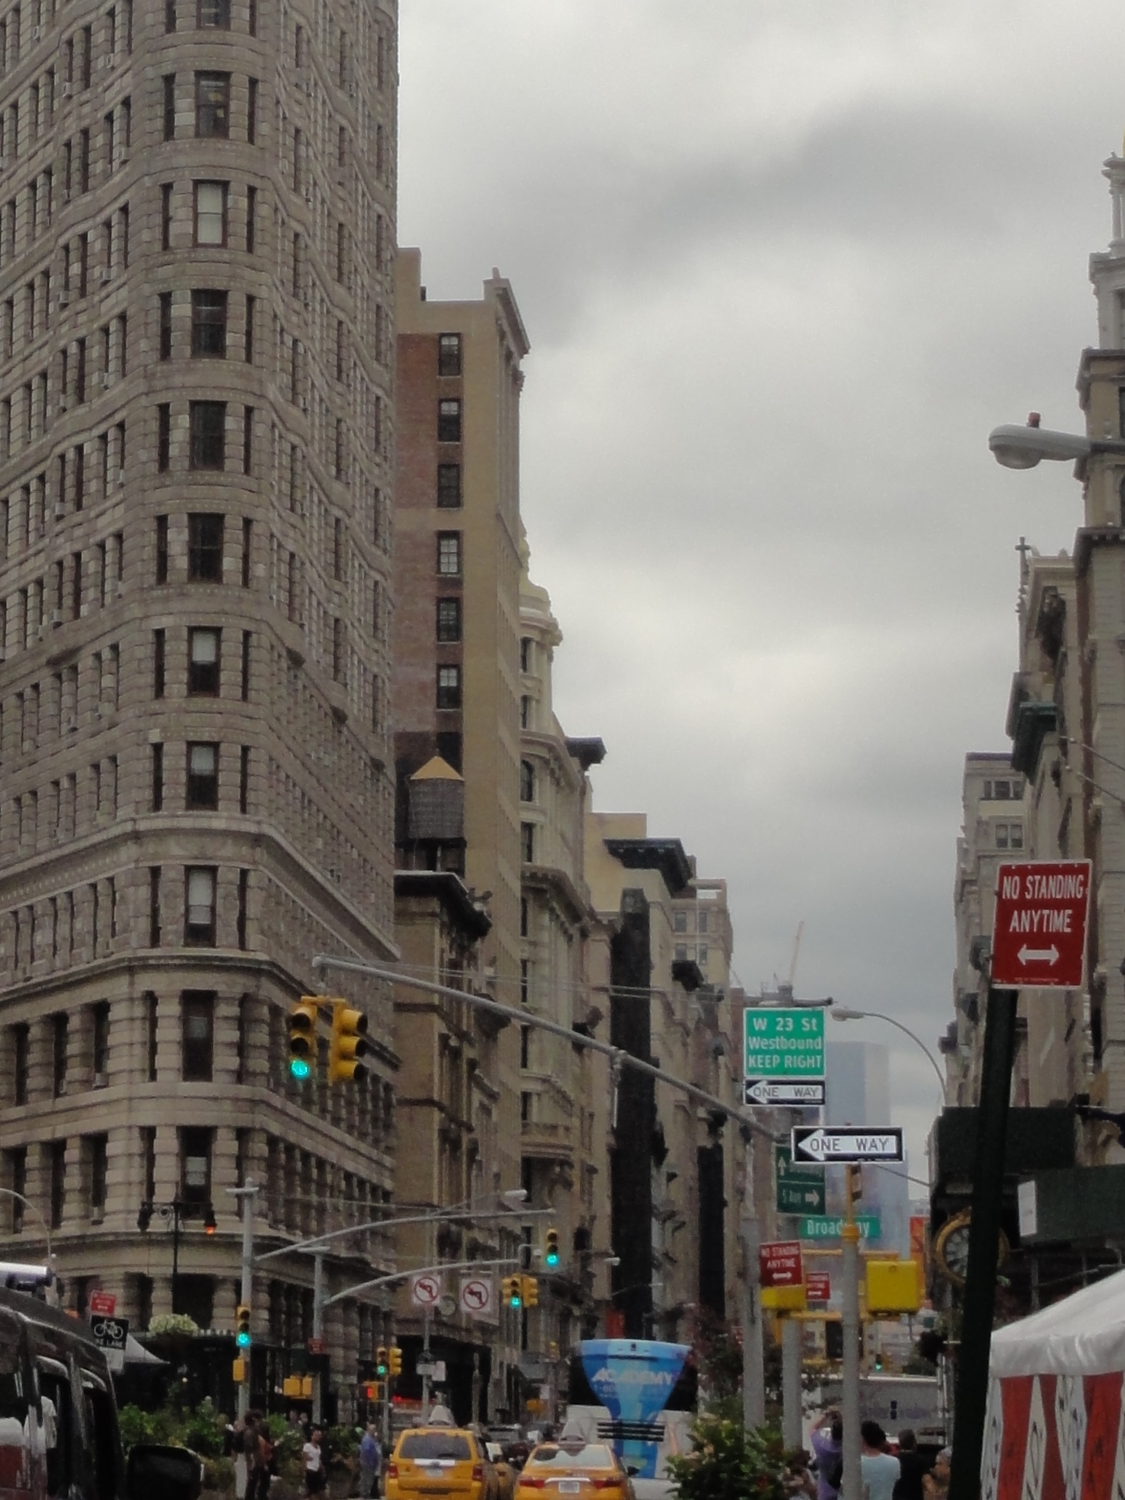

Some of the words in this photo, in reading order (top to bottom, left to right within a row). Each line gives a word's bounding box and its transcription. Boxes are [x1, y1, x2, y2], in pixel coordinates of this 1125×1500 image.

[1002, 875, 1020, 899] NO
[1025, 874, 1084, 899] STANDING
[1009, 909, 1073, 933] ANYTIME
[753, 1017, 768, 1031] W
[775, 1017, 794, 1031] 23
[801, 1017, 818, 1031] St
[748, 1036, 822, 1050] Westbound
[748, 1055, 780, 1068] KEEP
[784, 1055, 822, 1068] RIGHT
[753, 1086, 779, 1097] ONE
[793, 1086, 818, 1097] WAY
[810, 1138, 841, 1151] ONE
[856, 1138, 889, 1151] WAY
[767, 1258, 796, 1269] ANYTIME
